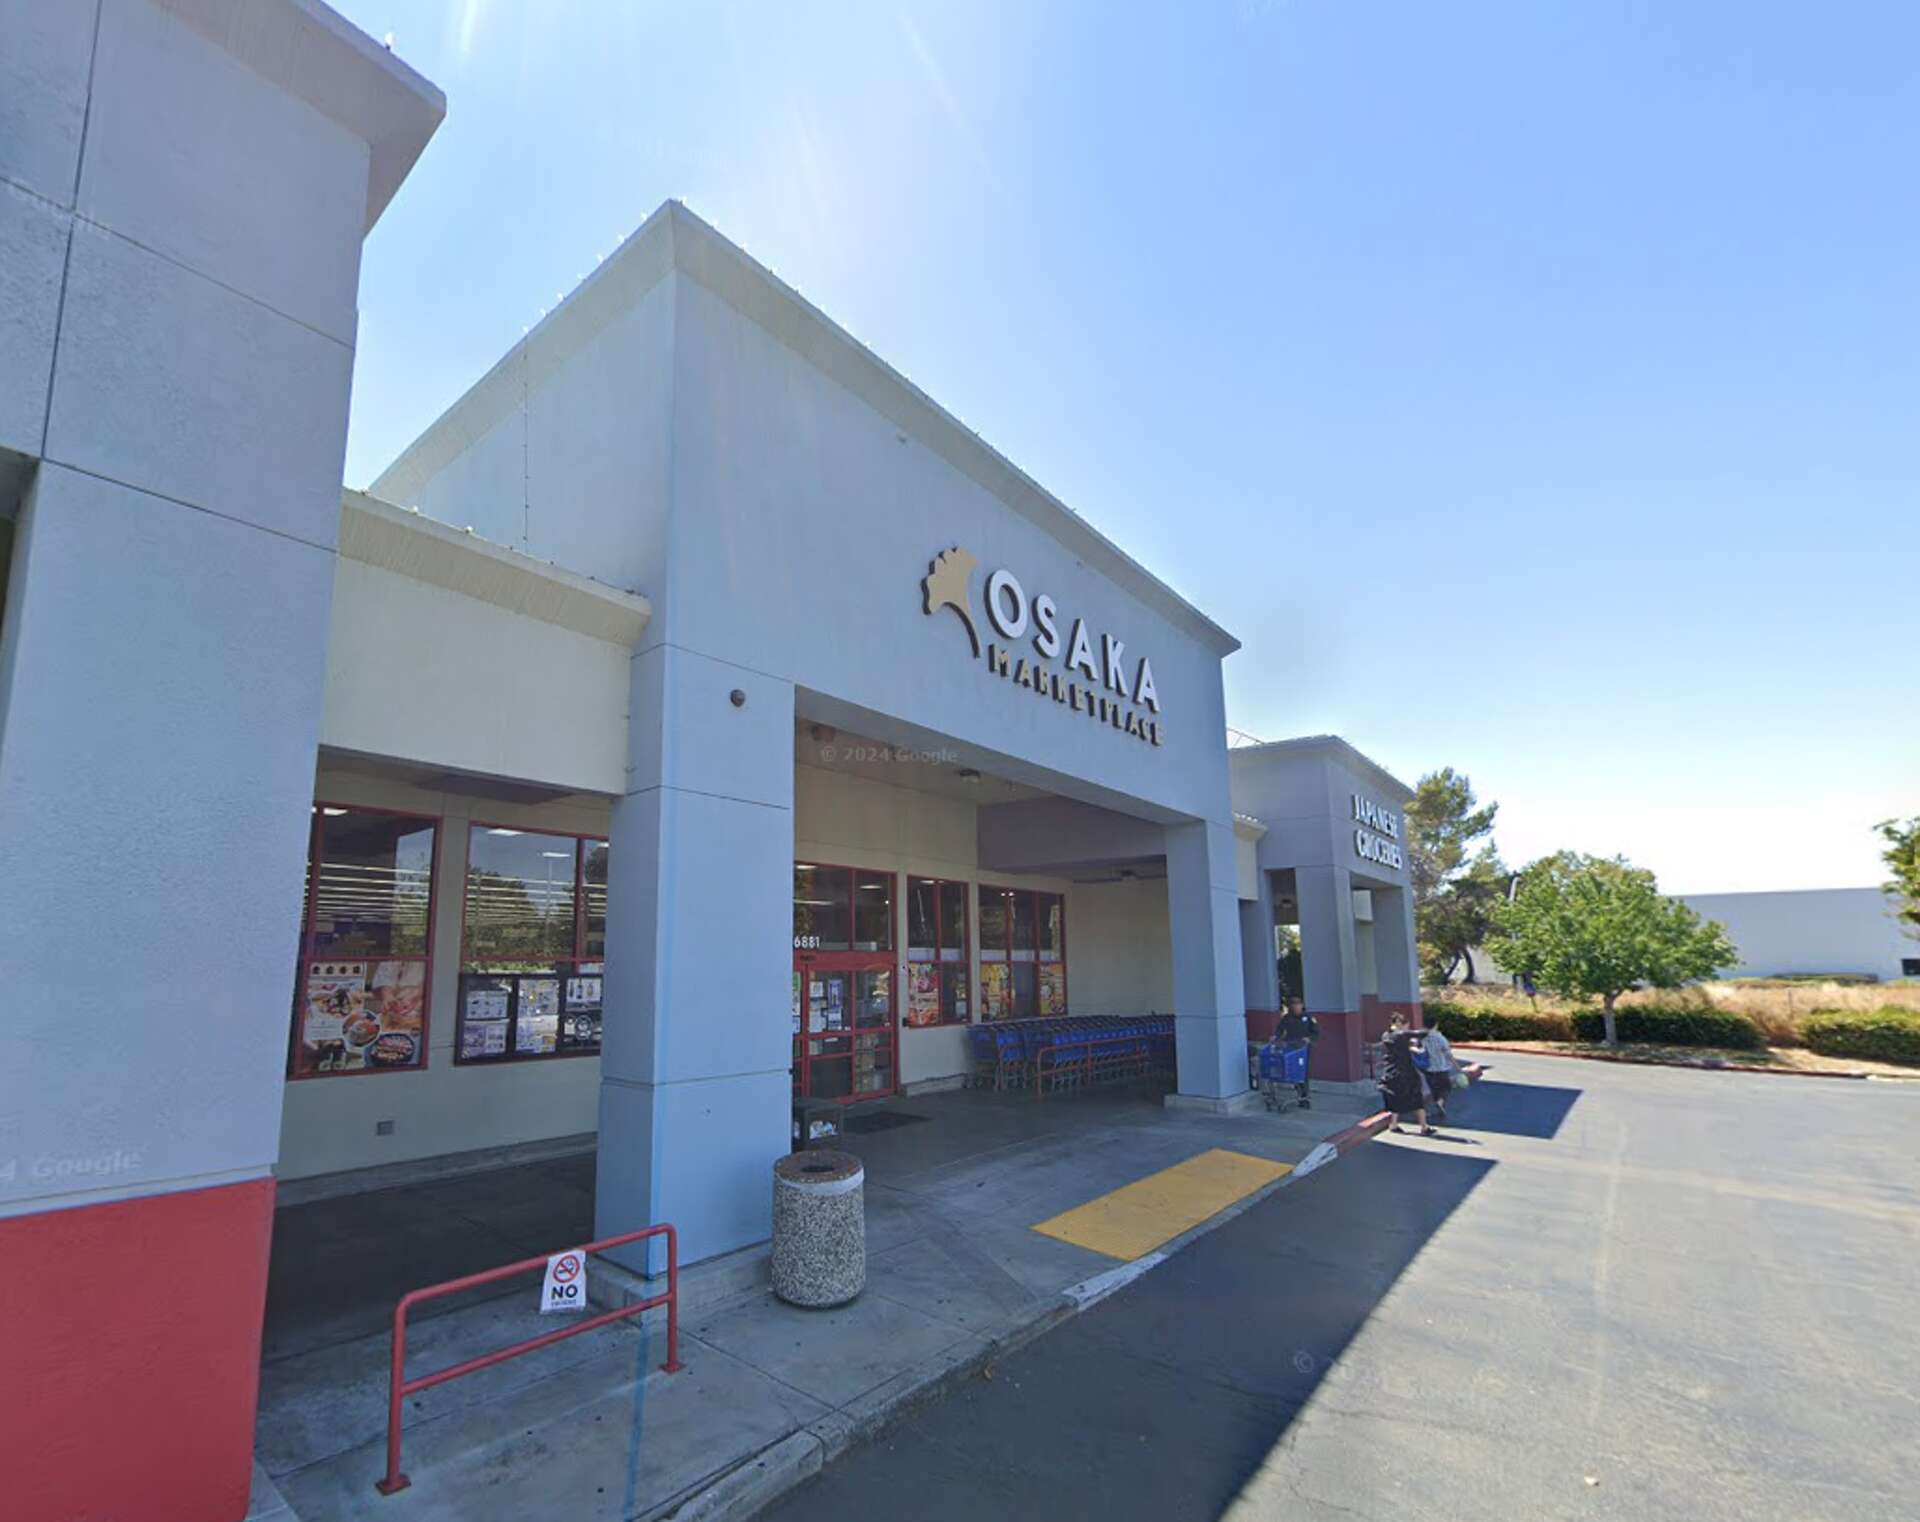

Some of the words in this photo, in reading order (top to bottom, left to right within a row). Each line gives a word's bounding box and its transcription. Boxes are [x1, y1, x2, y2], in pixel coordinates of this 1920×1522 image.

[984, 569, 1161, 713] OSAKA
[988, 643, 1163, 747] MARKETPLACE
[794, 935, 820, 949] 6881
[551, 1284, 578, 1300] NO
